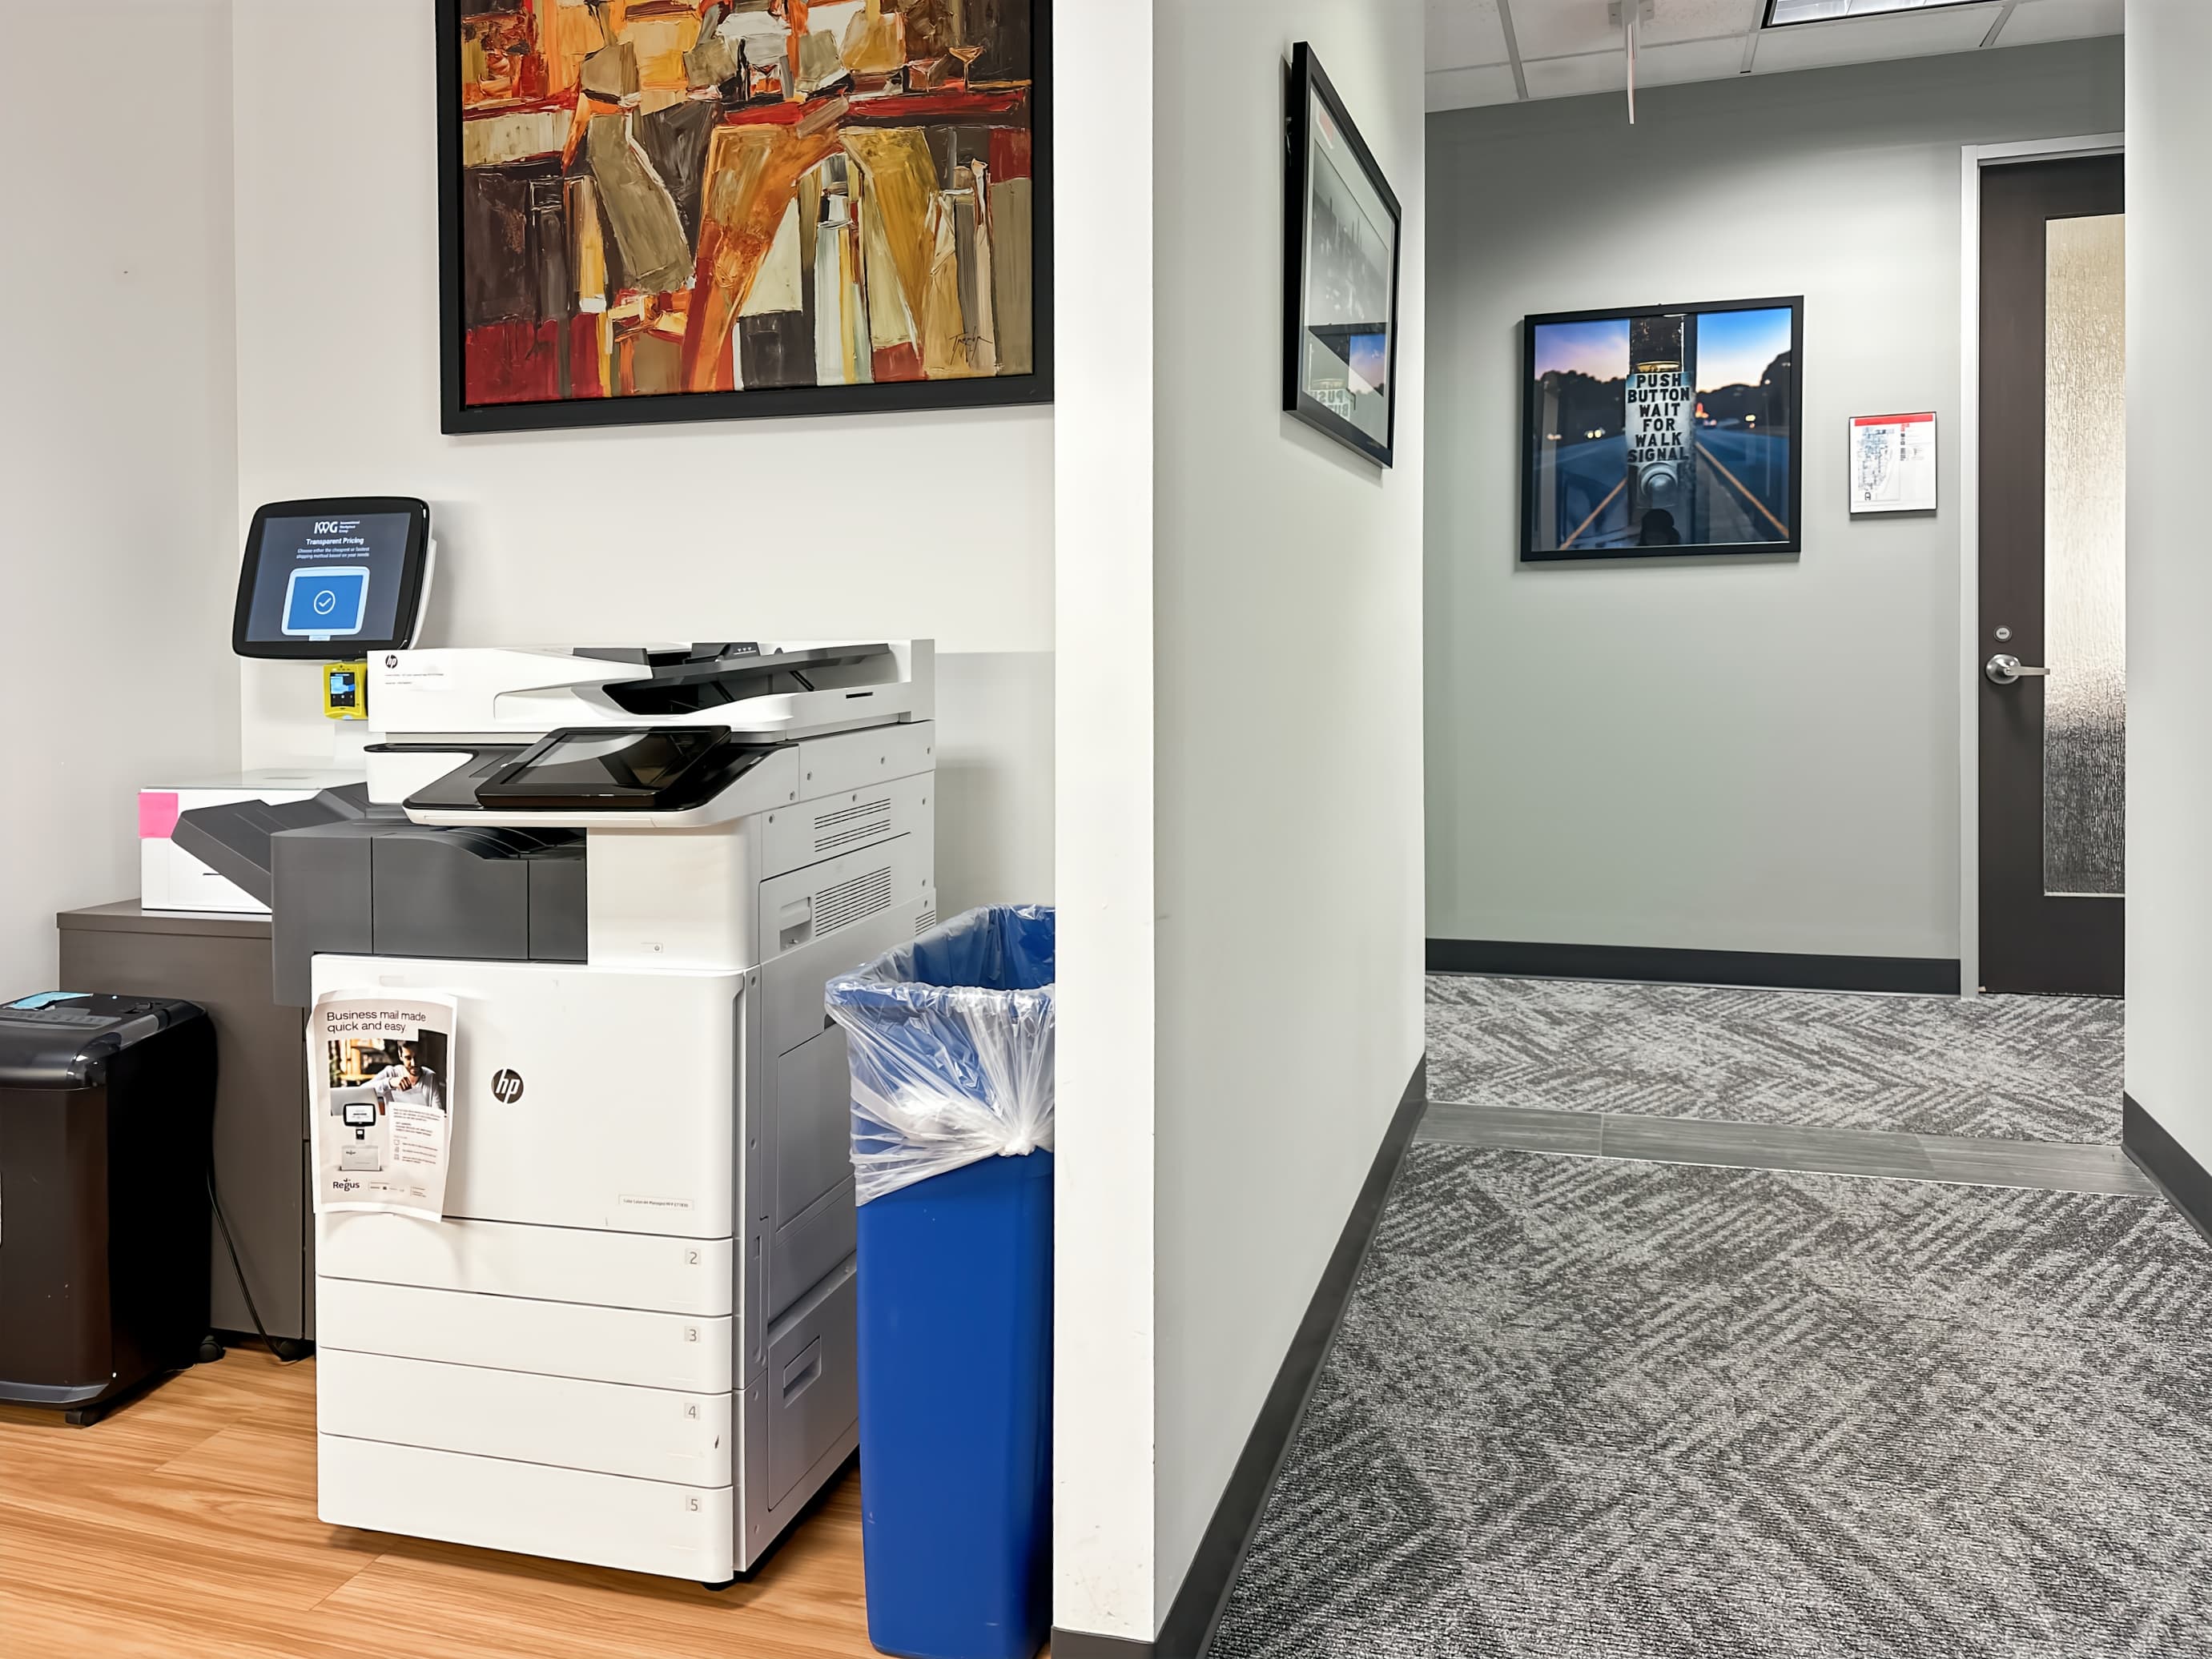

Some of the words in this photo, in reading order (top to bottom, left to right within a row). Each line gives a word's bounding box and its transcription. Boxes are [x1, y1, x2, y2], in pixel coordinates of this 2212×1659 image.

[1636, 373, 1682, 388] PUSH
[1627, 388, 1691, 403] BUTTON
[1639, 403, 1680, 417] WAIT
[1643, 418, 1675, 432] FOR
[1635, 432, 1682, 448] WALK
[1627, 447, 1690, 463] SIGNAL
[343, 536, 364, 545] Pricing
[327, 1010, 377, 1022] Business
[380, 1010, 399, 1019] mail
[401, 1012, 426, 1022] made
[327, 1021, 359, 1034] quick
[361, 1021, 382, 1030] and
[493, 1069, 523, 1103] hp
[332, 1180, 360, 1191] Regus
[689, 1251, 698, 1264] 2
[689, 1329, 697, 1341] 3
[689, 1405, 696, 1419] 4
[690, 1499, 698, 1511] 5
